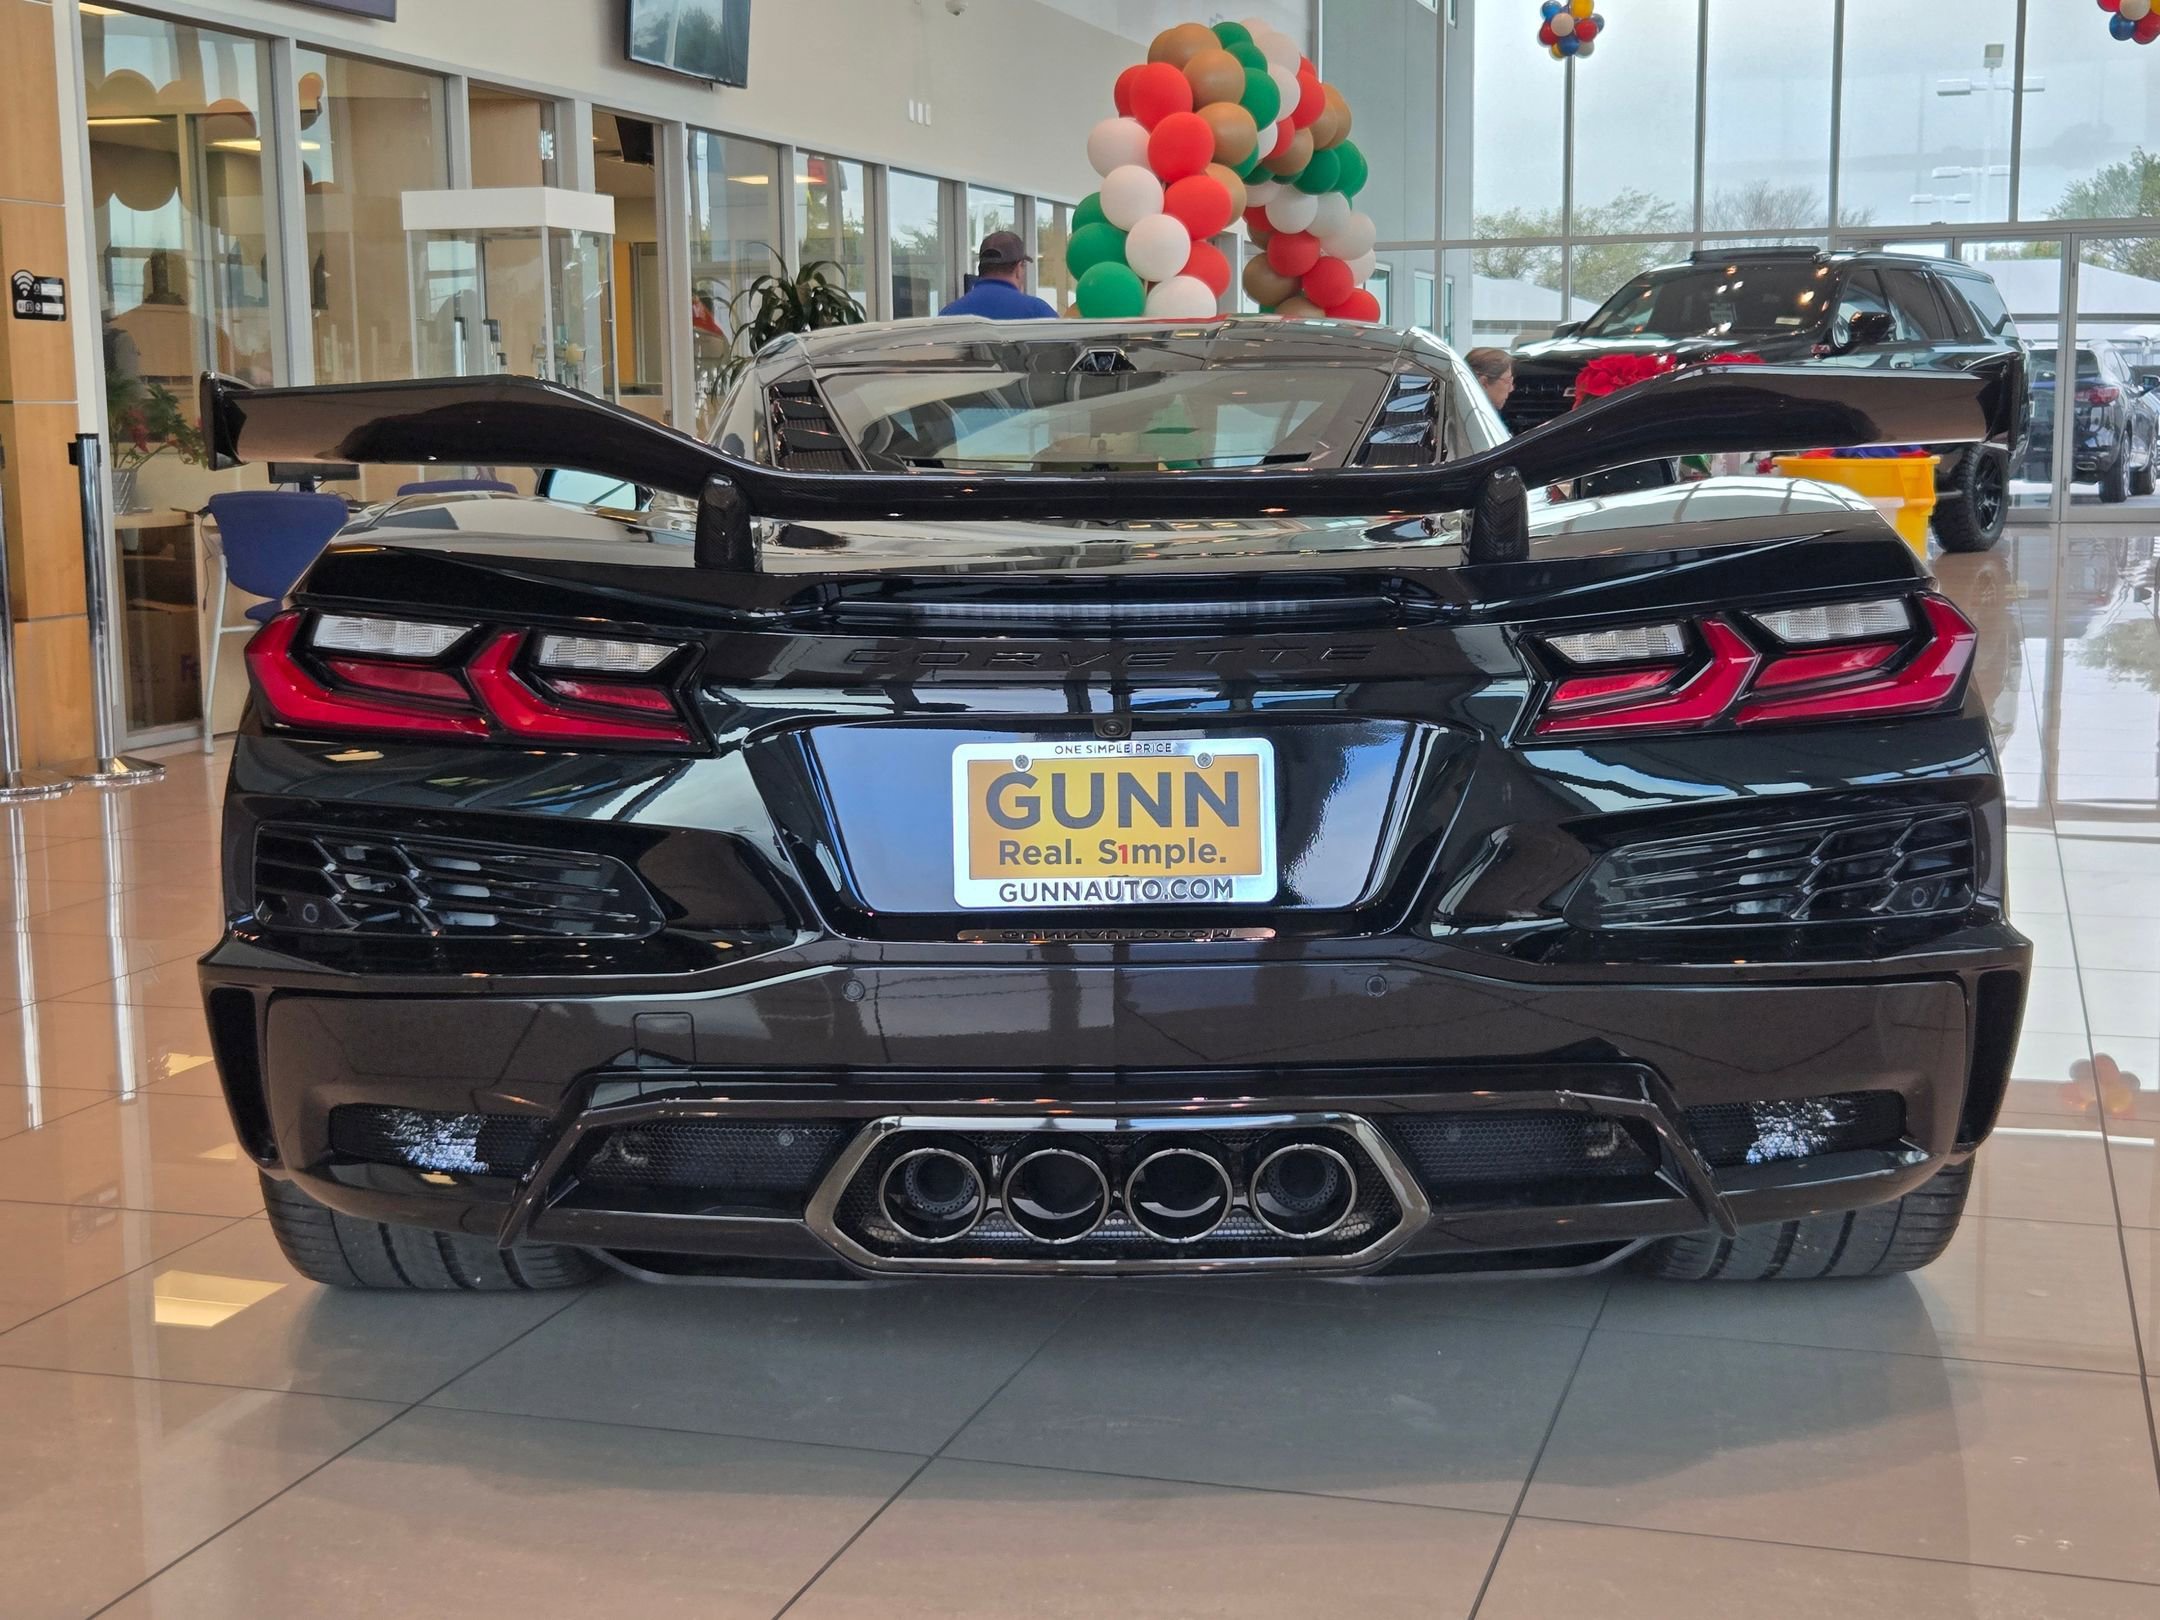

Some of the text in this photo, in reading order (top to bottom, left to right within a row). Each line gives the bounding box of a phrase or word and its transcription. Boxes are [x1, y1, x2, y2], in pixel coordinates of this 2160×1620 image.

[843, 645, 1377, 668] CORVETTE
[1055, 743, 1172, 755] ONE SIMPLE PRICE
[986, 771, 1240, 830] GUNN
[1000, 837, 1227, 868] Real. S1mple.
[999, 878, 1234, 902] GUNNAUTO.COM
